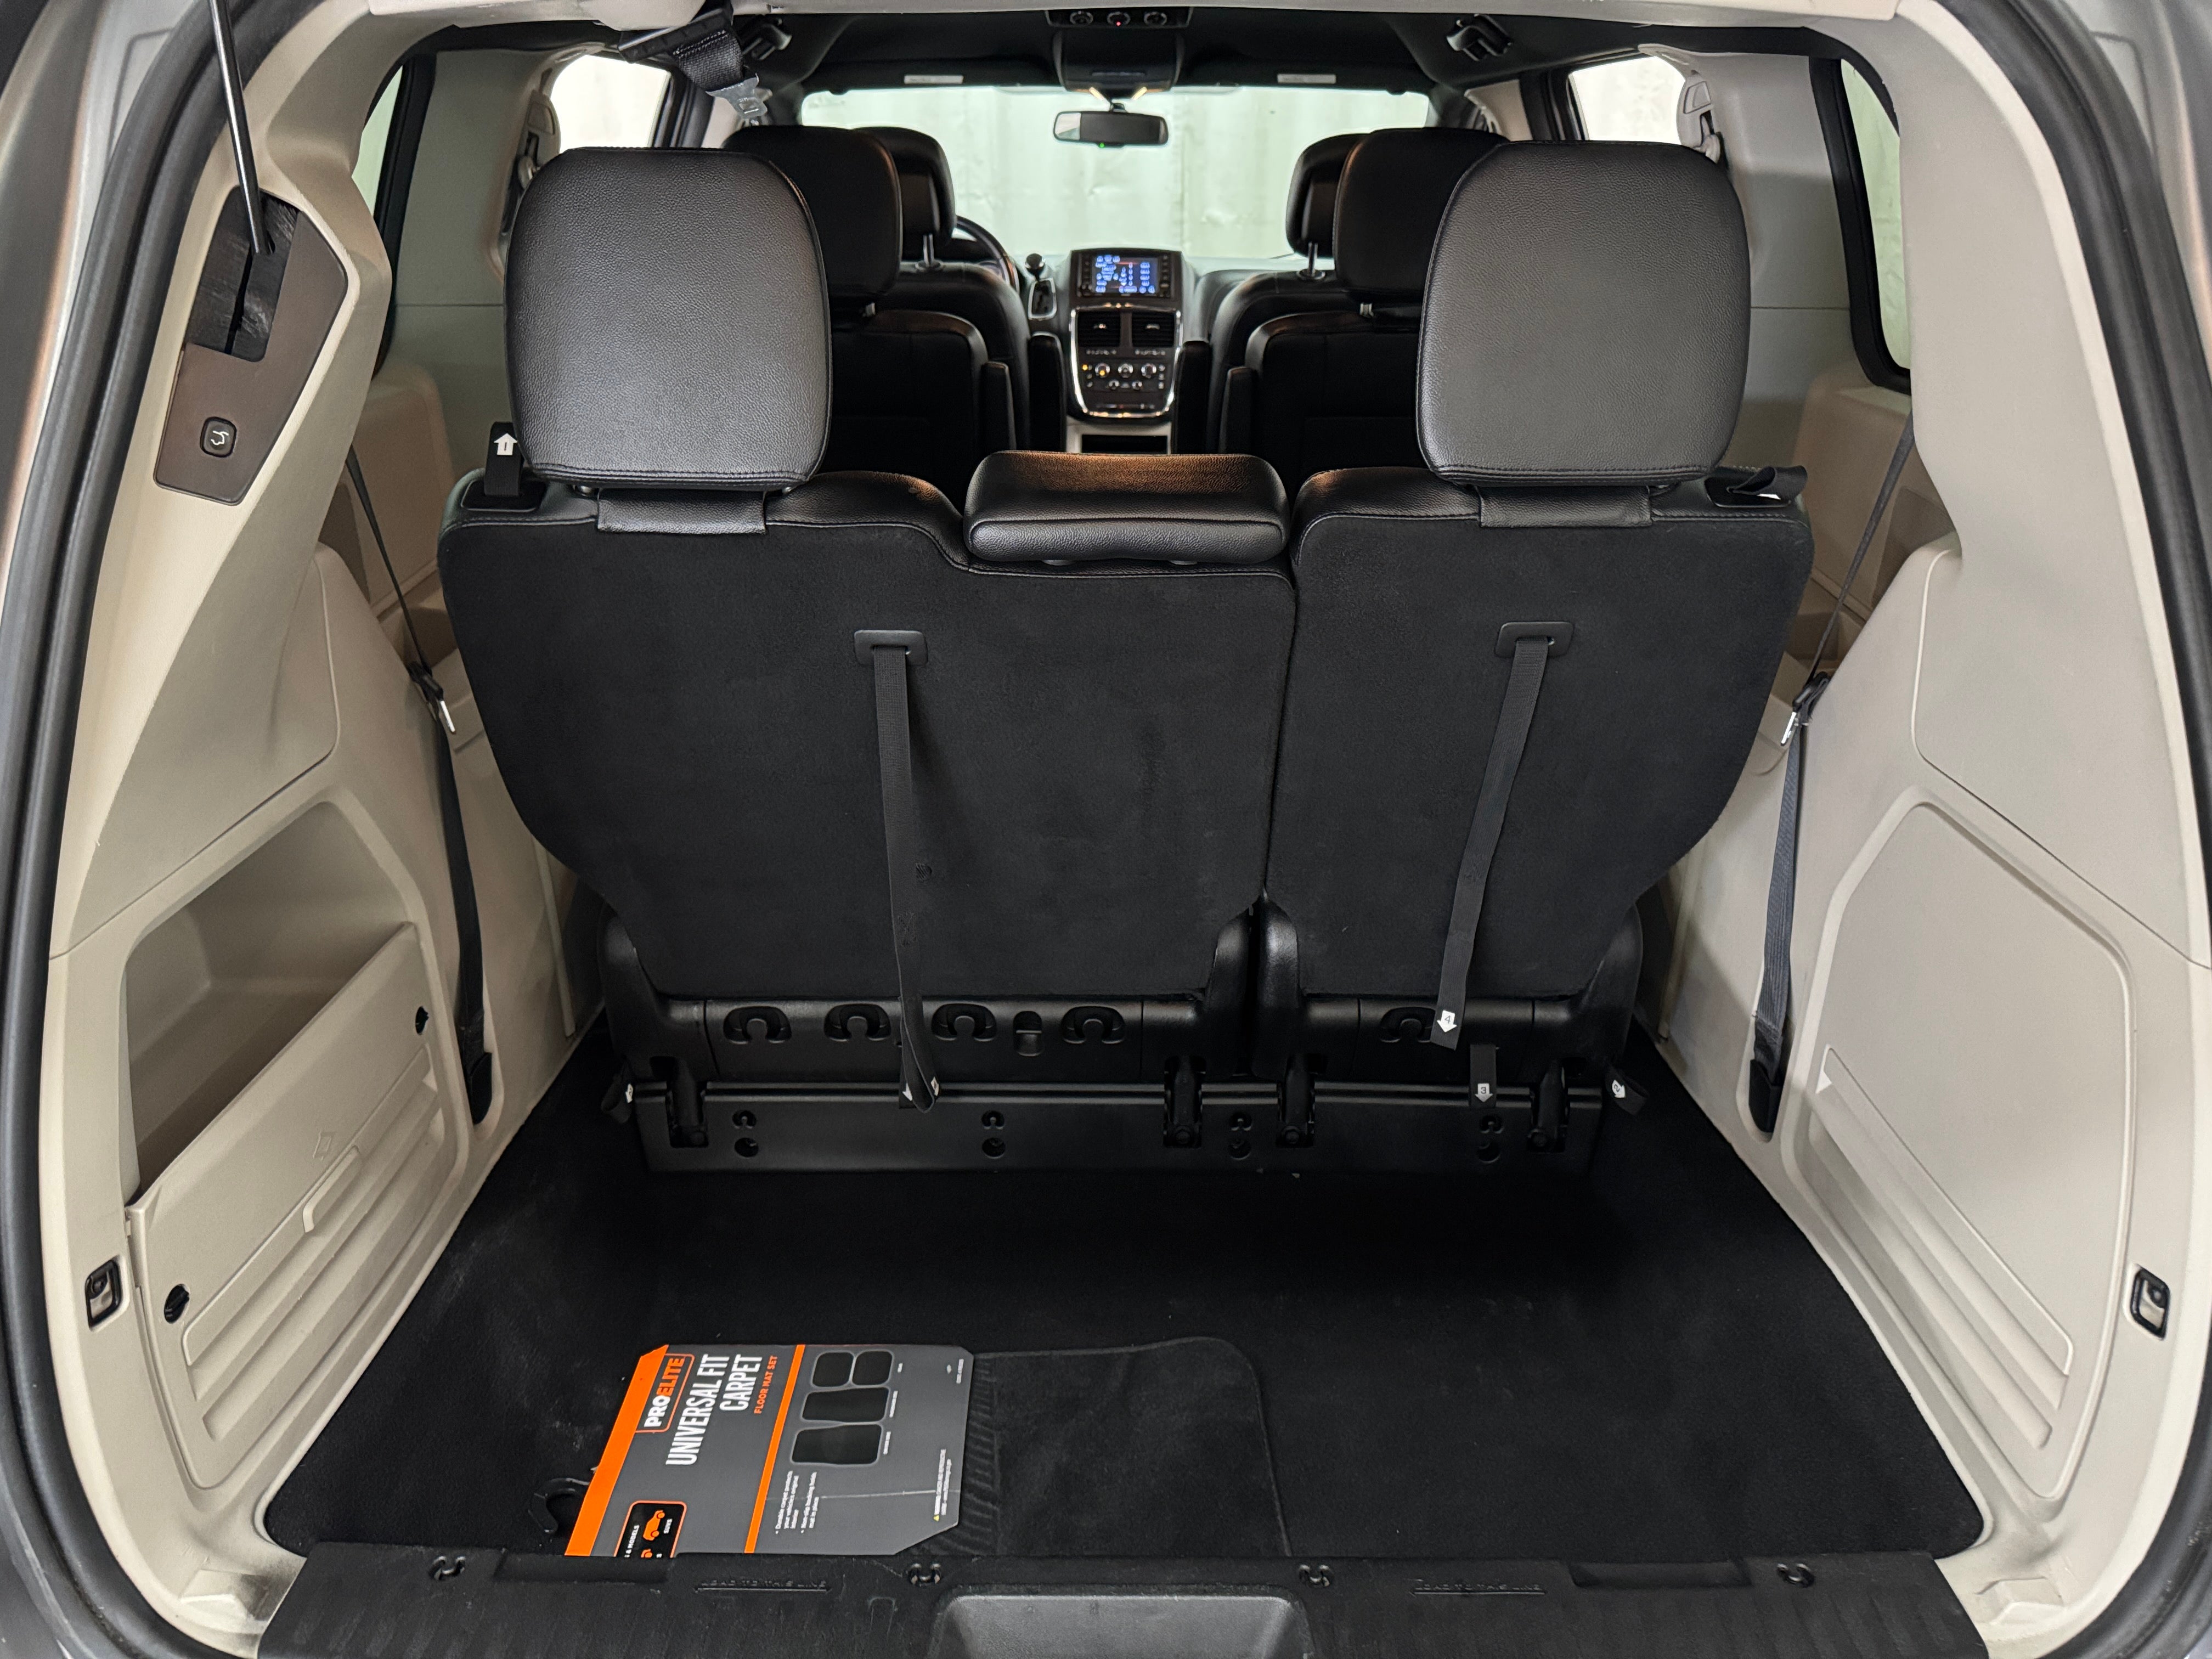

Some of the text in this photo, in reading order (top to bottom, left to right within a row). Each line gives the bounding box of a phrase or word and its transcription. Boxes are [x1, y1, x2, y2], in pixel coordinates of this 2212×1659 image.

[1444, 1015, 1451, 1024] 4
[1480, 1086, 1487, 1094] 3
[1613, 1084, 1621, 1093] 2
[644, 1358, 684, 1427] PROELITE
[719, 1353, 763, 1411] CARPET
[754, 1355, 778, 1414] FLOOR MAT SET
[665, 1353, 730, 1465] UNIVERSAL FIT
[781, 1492, 789, 1509] carpet
[627, 1525, 640, 1549] MODELS
